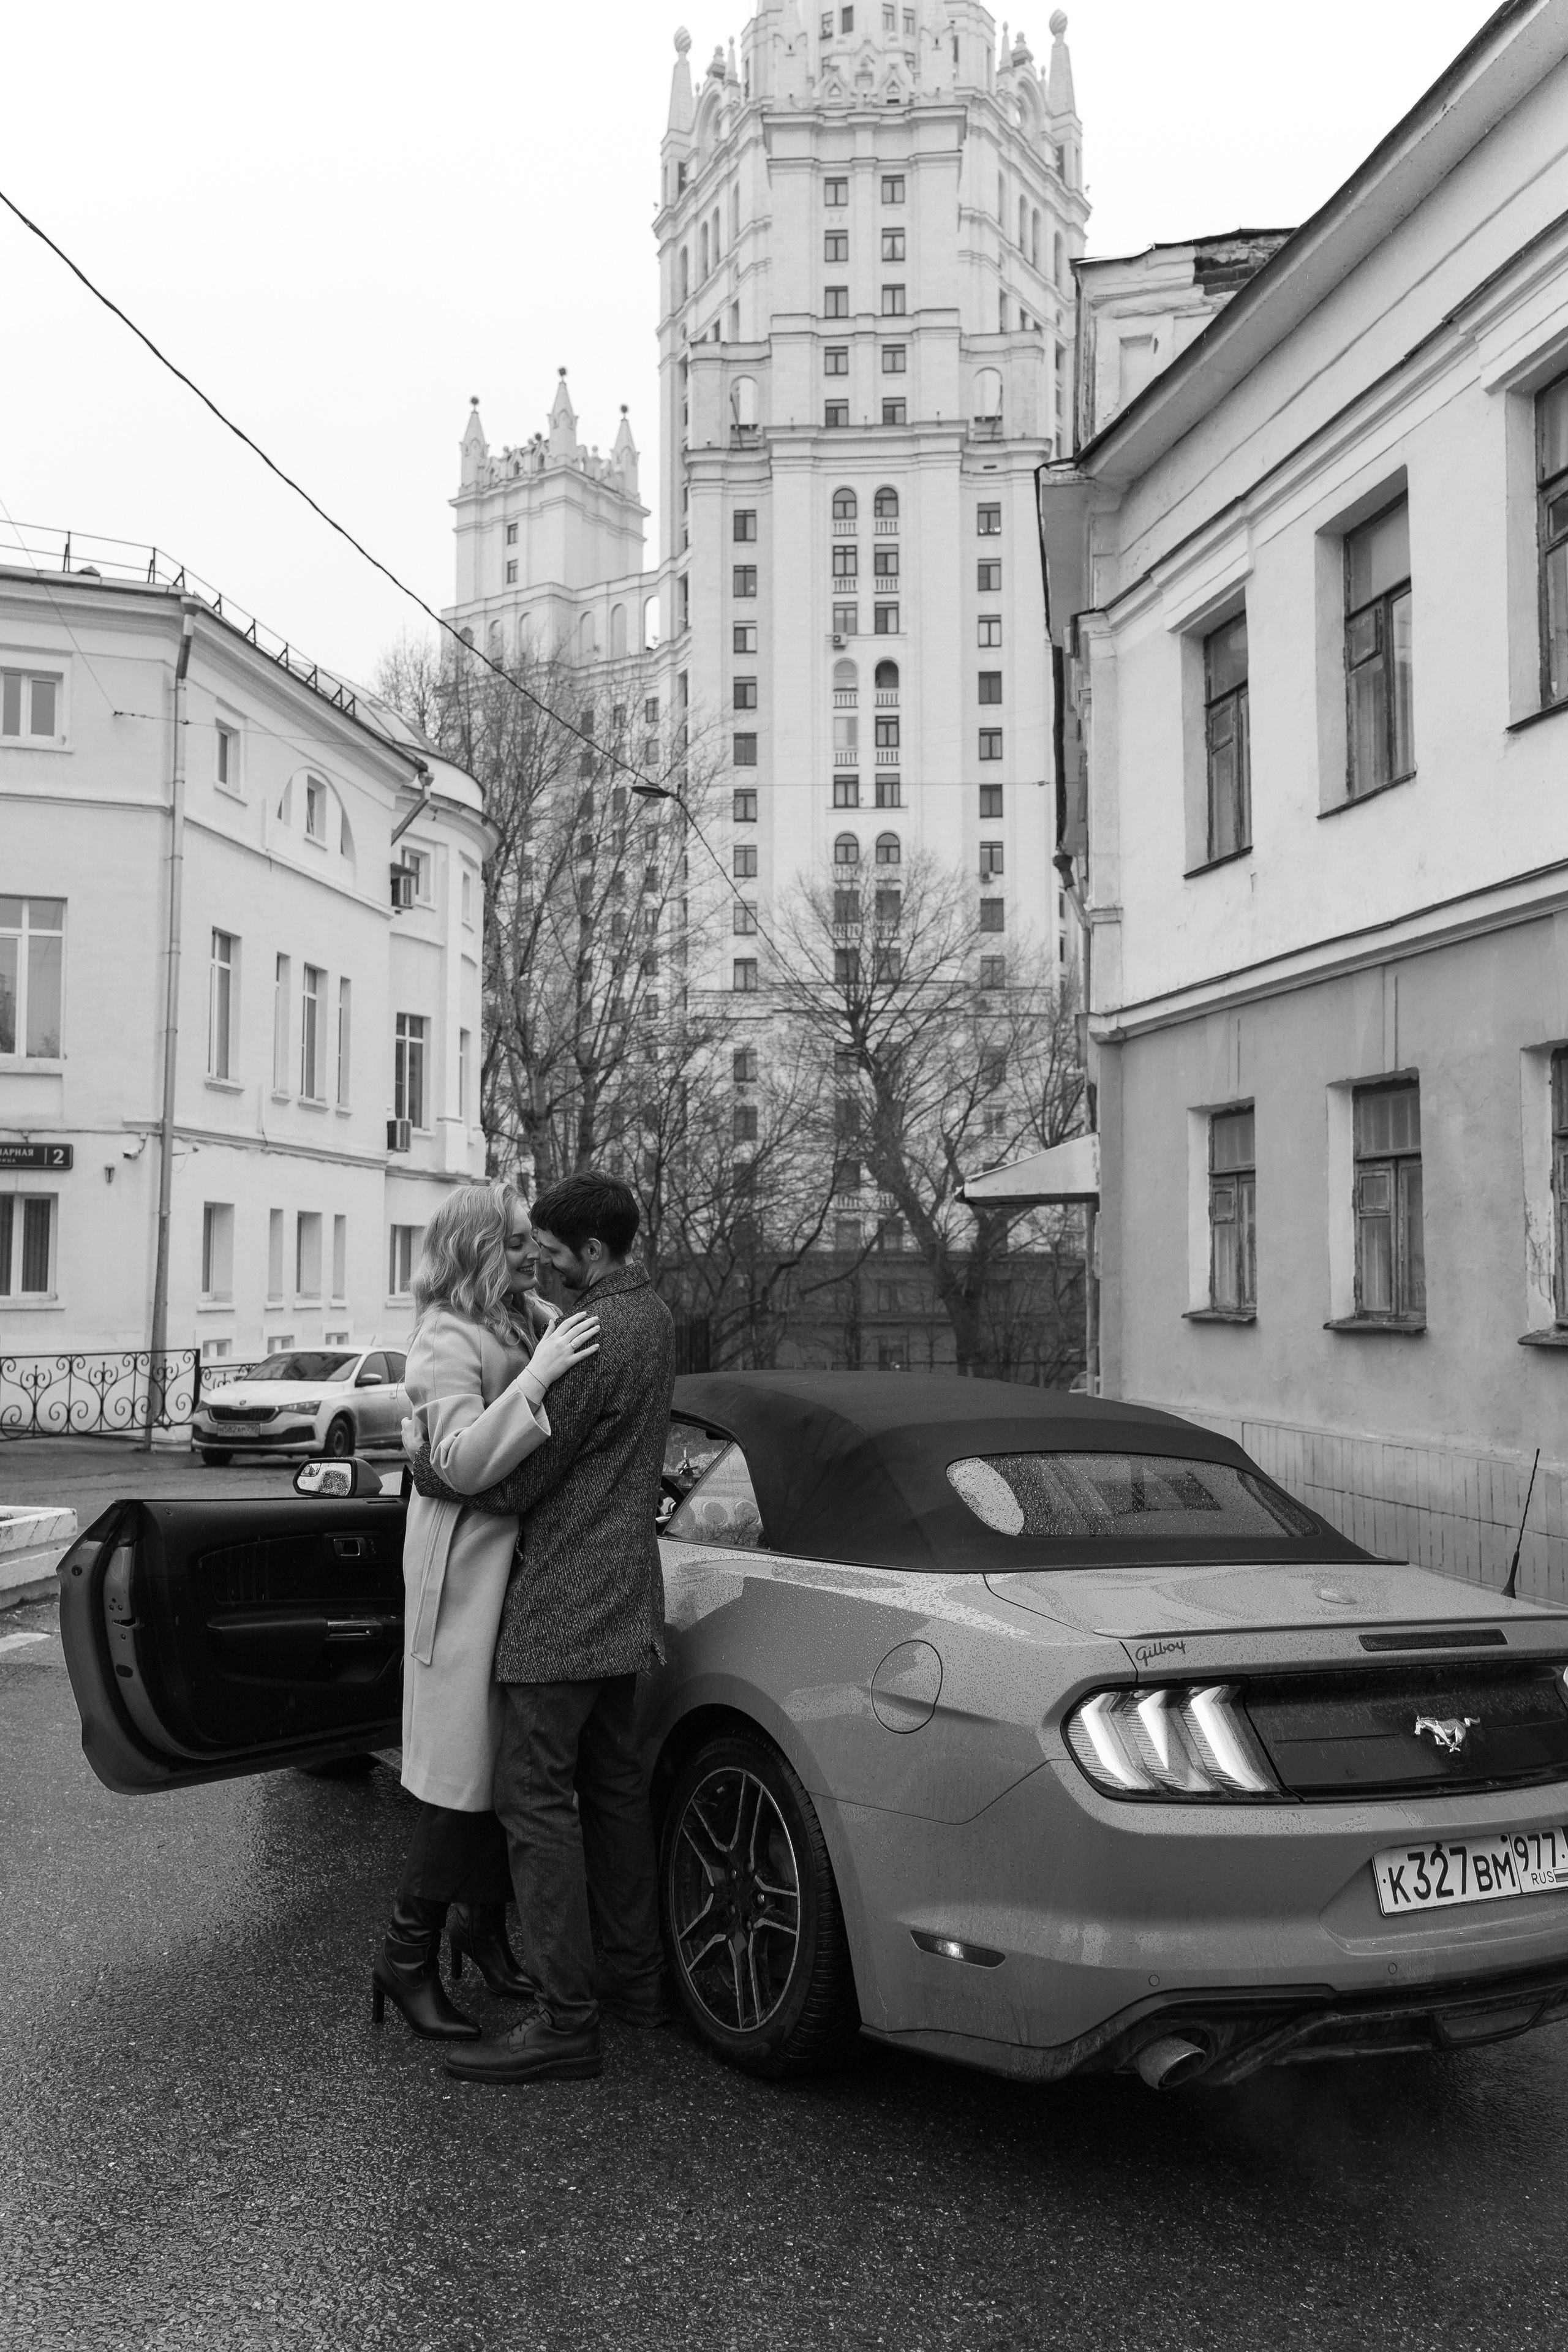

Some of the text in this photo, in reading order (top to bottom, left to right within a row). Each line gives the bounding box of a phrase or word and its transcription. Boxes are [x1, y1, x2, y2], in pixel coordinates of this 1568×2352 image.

[53, 1149, 64, 1164] 2
[1136, 1641, 1186, 1666] Gilboy
[1513, 1831, 1556, 1872] 977
[1531, 1871, 1554, 1885] RUS
